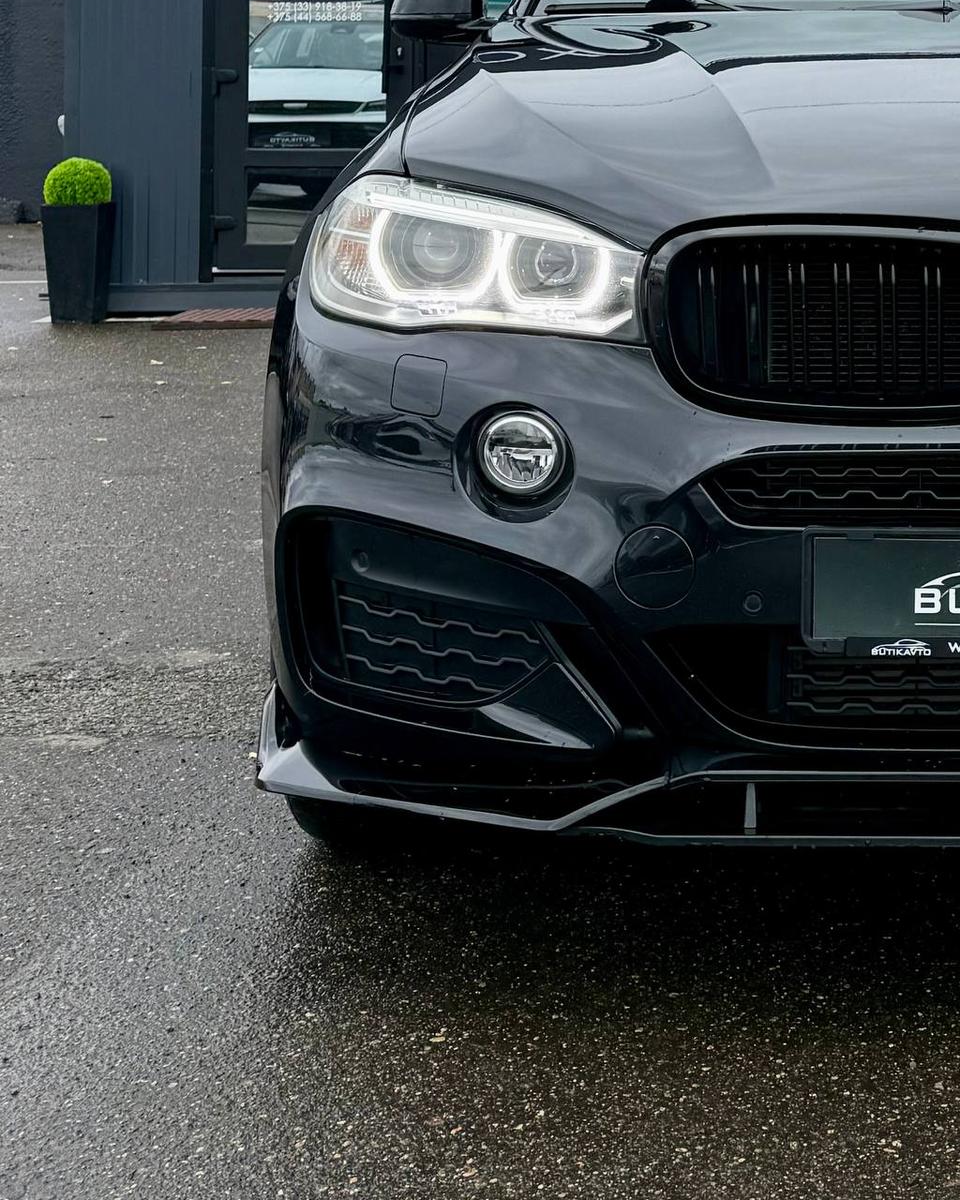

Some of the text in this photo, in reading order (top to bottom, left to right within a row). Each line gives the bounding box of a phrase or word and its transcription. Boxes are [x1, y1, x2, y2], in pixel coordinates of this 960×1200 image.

[267, 1, 292, 12] +375
[293, 1, 312, 14] (33)
[267, 12, 292, 22] +375
[293, 11, 312, 23] (44)
[871, 647, 931, 657] BUTIKAVTO
